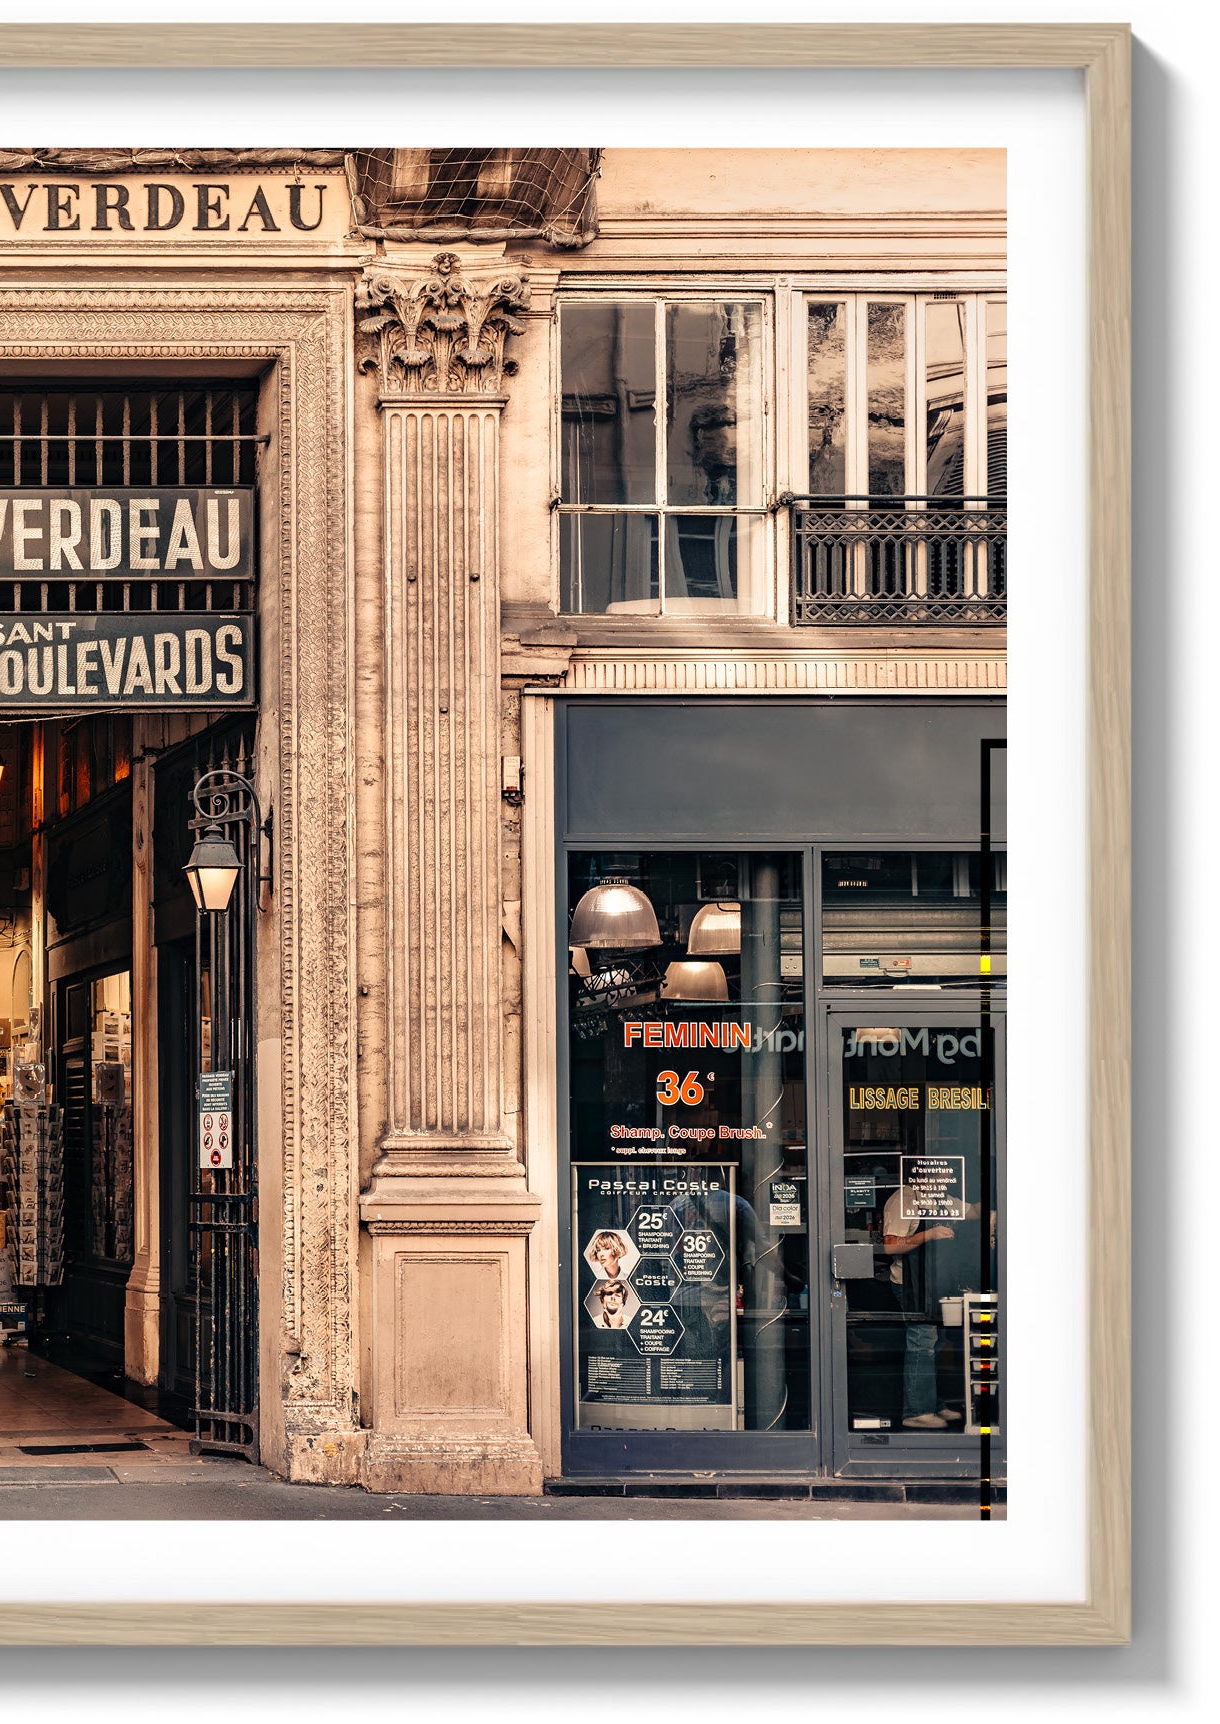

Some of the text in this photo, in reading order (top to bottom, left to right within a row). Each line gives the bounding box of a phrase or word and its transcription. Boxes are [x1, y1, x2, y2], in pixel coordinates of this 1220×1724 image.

[623, 1021, 751, 1048] FEMININ
[849, 1087, 919, 1109] LISSAGE
[610, 1125, 665, 1141] Shamp.
[668, 1125, 715, 1141] Coupe
[589, 1180, 720, 1190] Pascal Coste
[638, 1212, 667, 1229] 25€
[683, 1235, 711, 1252] 36€
[640, 1309, 669, 1326] 24€
